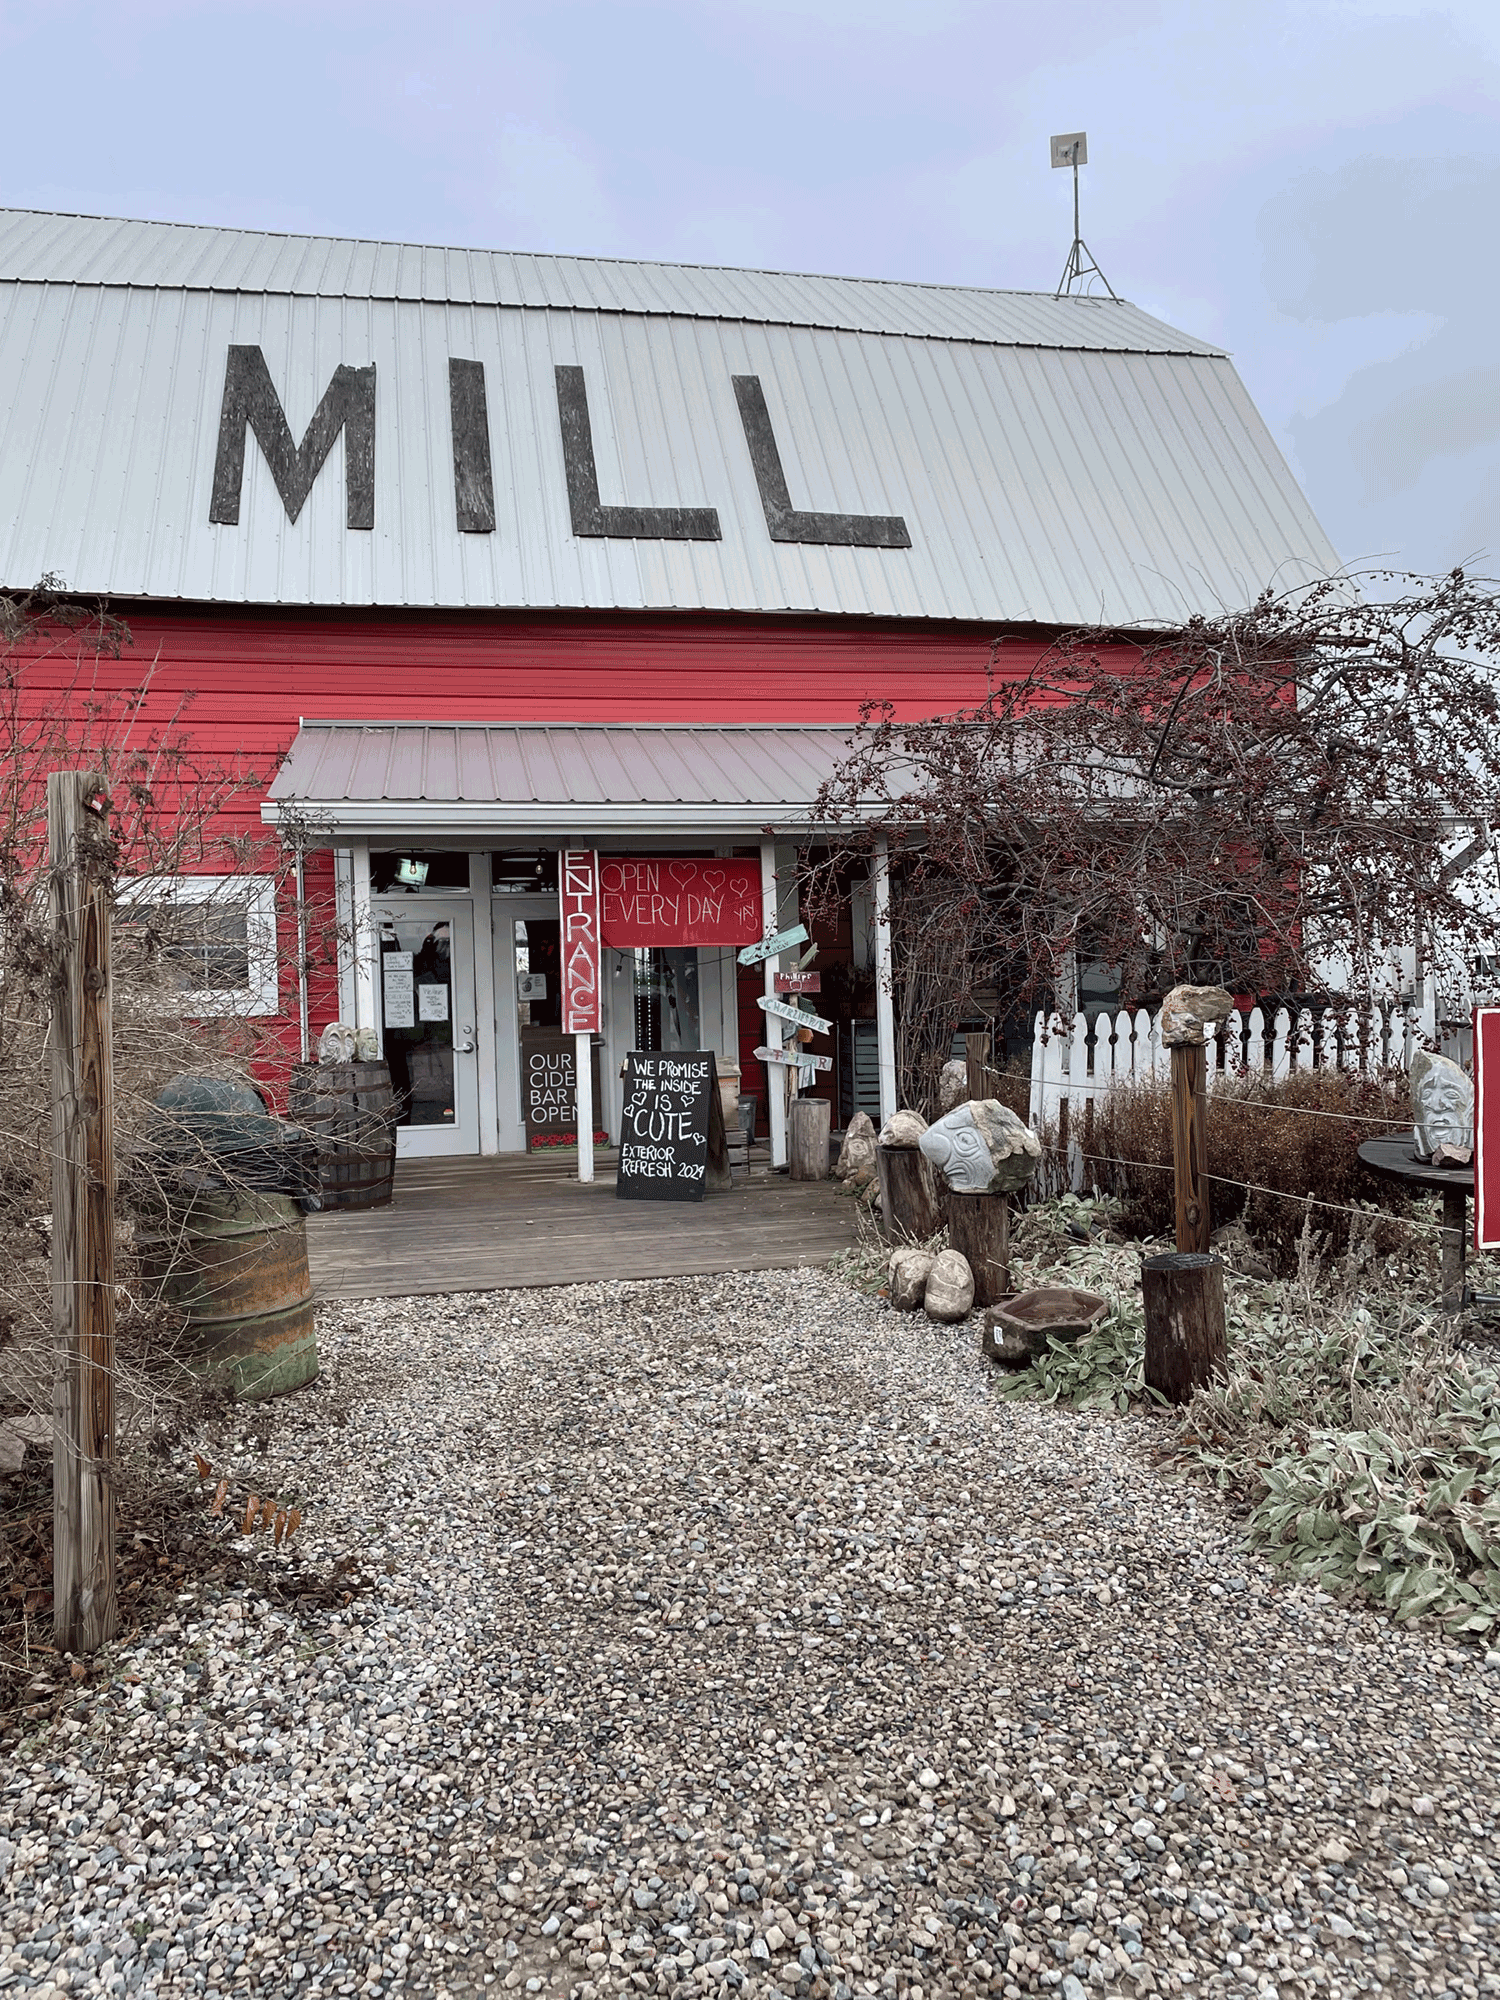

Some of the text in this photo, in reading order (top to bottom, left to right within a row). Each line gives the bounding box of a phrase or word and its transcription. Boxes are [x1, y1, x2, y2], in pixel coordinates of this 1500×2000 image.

[209, 344, 912, 548] MILL
[600, 863, 659, 893] OPEN
[603, 892, 725, 927] EVERY DAY
[564, 849, 596, 1034] ENTRANCE
[529, 1053, 572, 1070] OUR
[633, 1058, 709, 1079] WE PROMISE
[529, 1070, 576, 1088] CIDE
[633, 1078, 702, 1095] THE INSIDE
[530, 1088, 568, 1106] BAR
[654, 1094, 673, 1112] IS
[633, 1108, 693, 1142] CUTE
[621, 1143, 677, 1165] EXTERIOR
[621, 1159, 673, 1178] REFRESH
